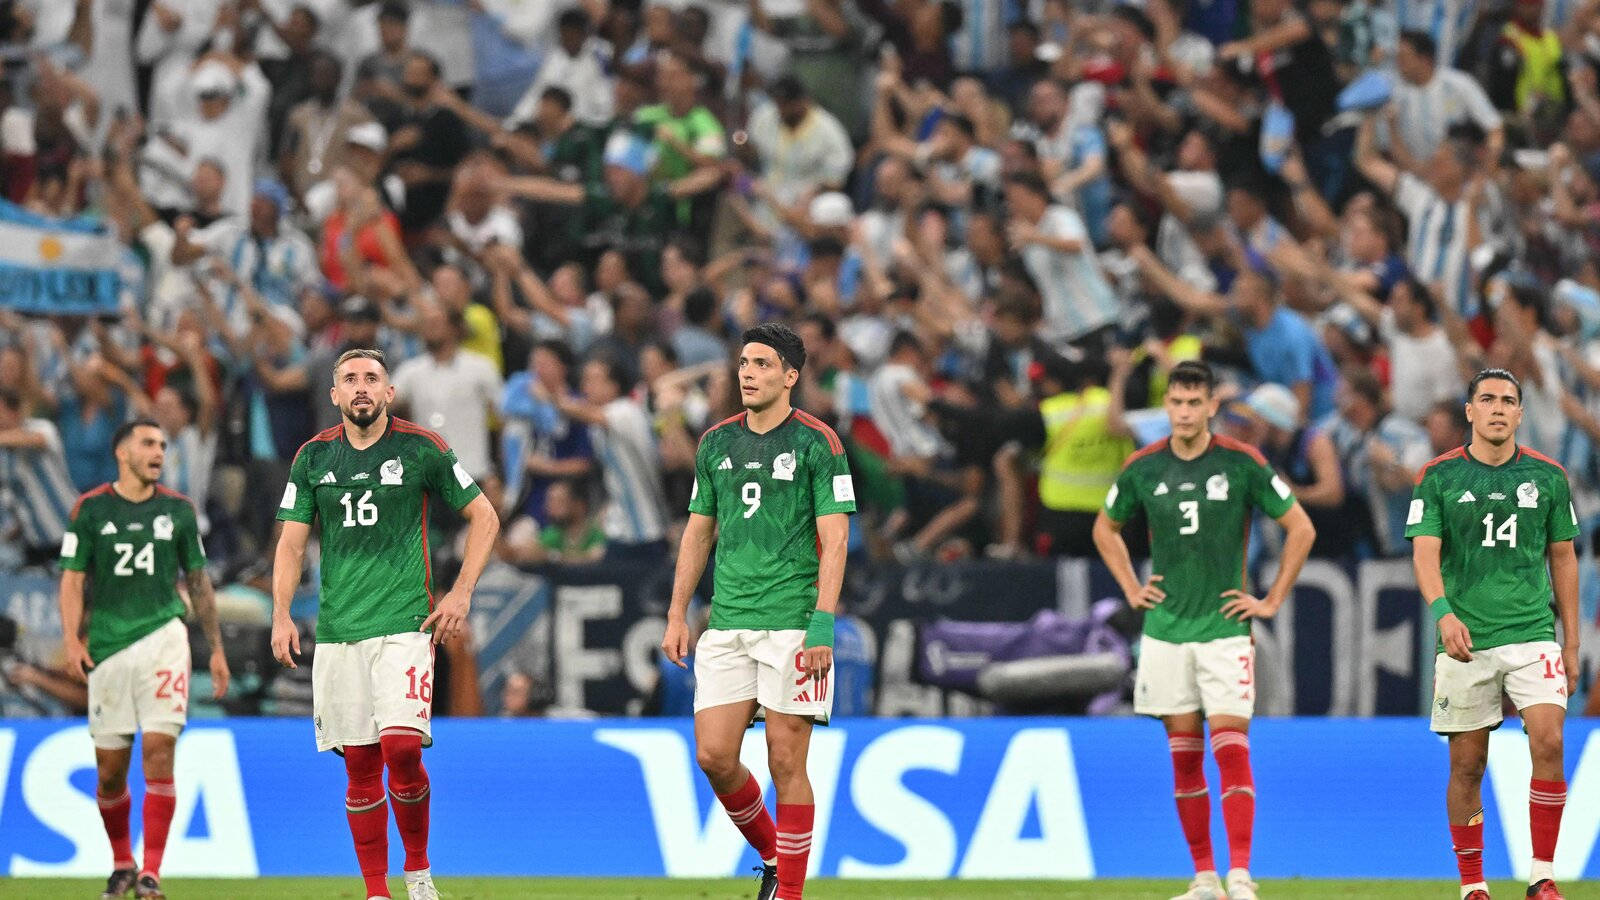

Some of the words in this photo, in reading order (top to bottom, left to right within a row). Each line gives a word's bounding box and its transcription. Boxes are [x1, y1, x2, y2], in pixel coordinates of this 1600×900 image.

[340, 490, 379, 527] 16
[742, 482, 761, 519] 9
[1178, 500, 1199, 535] 3
[1481, 512, 1517, 548] 14
[114, 542, 155, 576] 24
[155, 670, 186, 700] 24
[405, 666, 431, 704] 16
[0, 727, 259, 879] SA
[594, 725, 1098, 879] VISA
